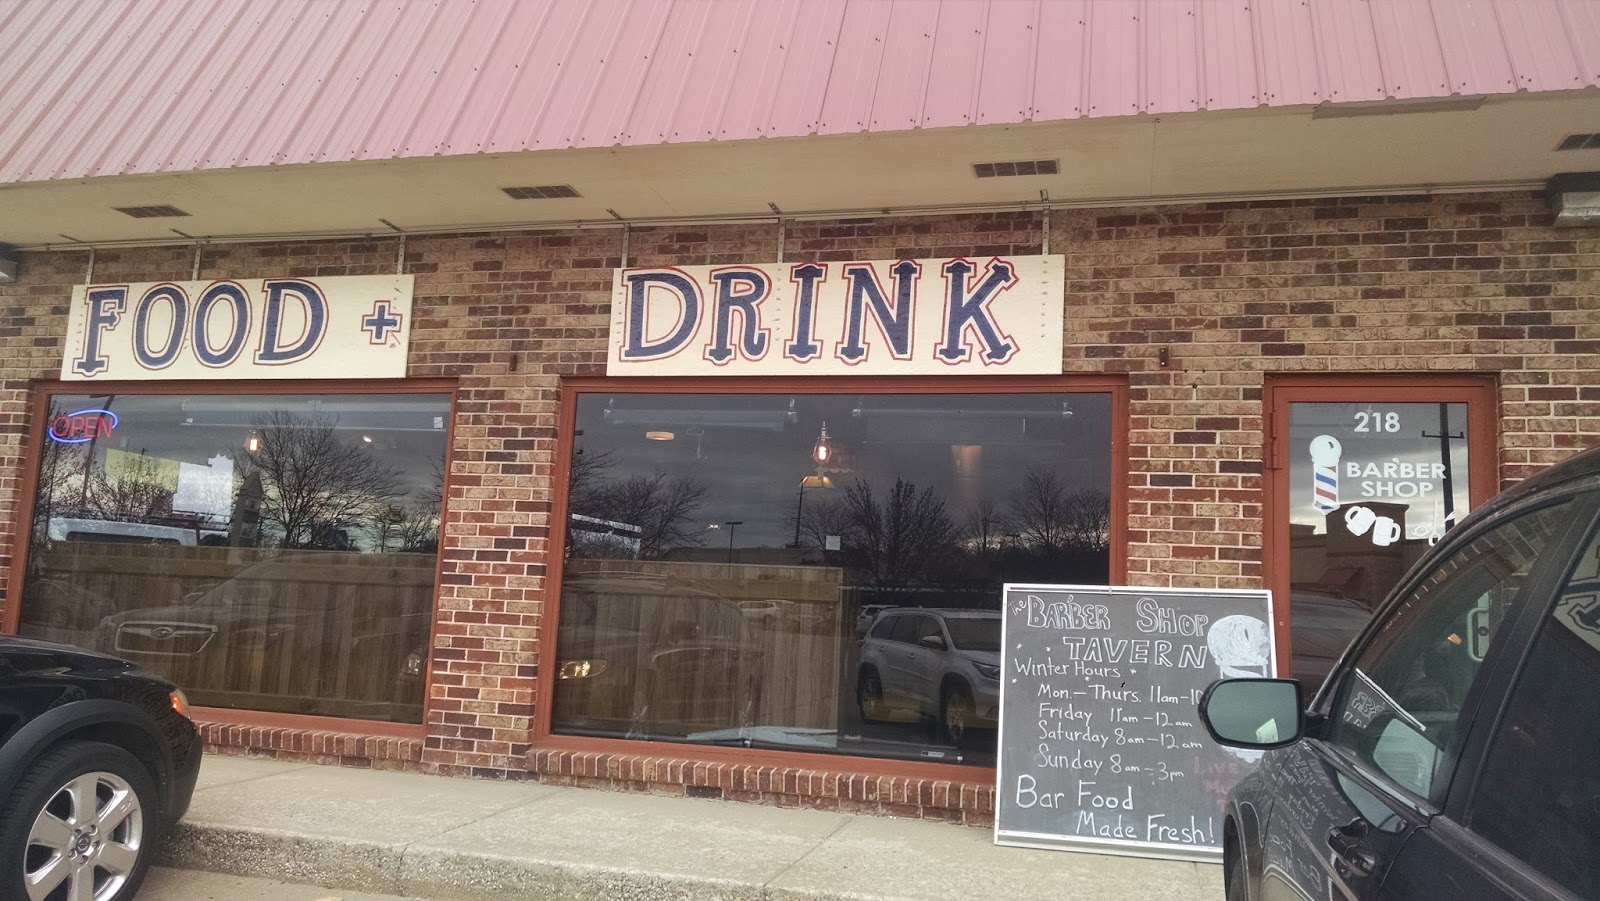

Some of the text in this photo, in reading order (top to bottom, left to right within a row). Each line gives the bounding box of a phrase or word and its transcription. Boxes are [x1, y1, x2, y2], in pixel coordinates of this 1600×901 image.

[72, 278, 330, 377] FOOD
[618, 256, 1021, 368] DRINK
[52, 415, 113, 438] OPEN
[1353, 411, 1401, 433] 218
[1360, 480, 1434, 498] SHOP
[1014, 657, 1122, 679] Winter Hours
[1062, 636, 1208, 669] TAVERN
[1038, 702, 1094, 727] Friday
[1038, 719, 1110, 749] Saturday
[1038, 742, 1103, 776] Sunday
[1015, 773, 1134, 810] Bar Food
[1075, 809, 1216, 845] Made Fresh!
